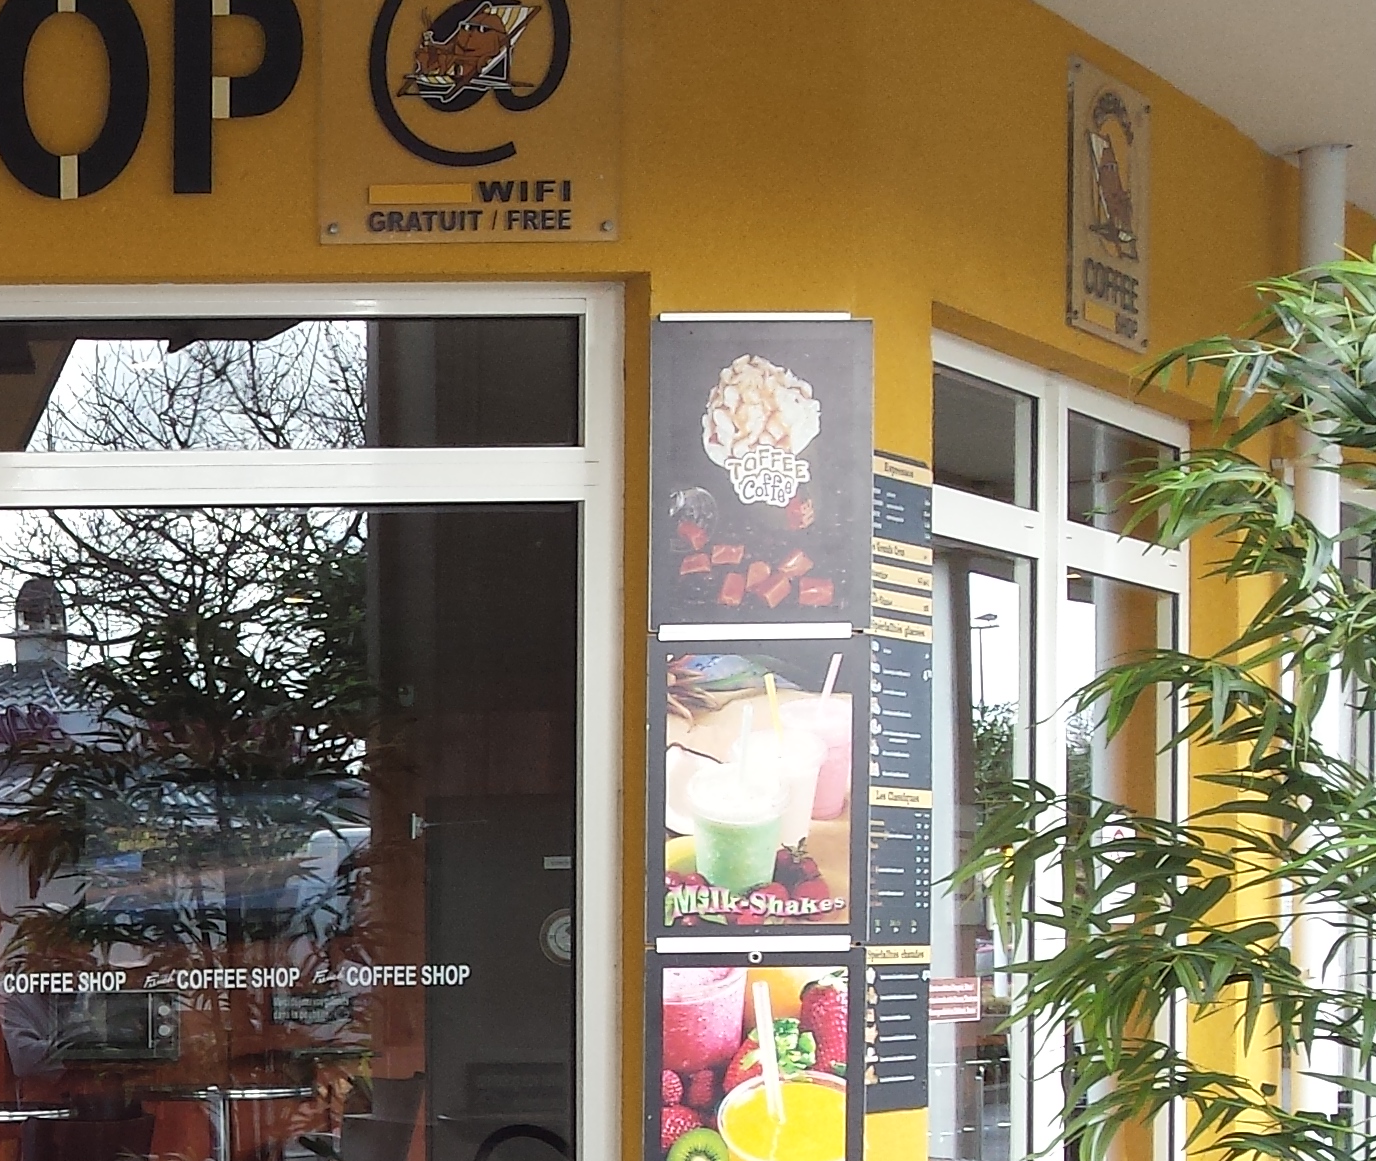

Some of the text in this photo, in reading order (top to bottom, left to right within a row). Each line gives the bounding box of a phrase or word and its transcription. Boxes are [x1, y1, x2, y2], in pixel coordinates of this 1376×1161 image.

[477, 180, 573, 204] WIFI
[366, 208, 484, 234] GRATUIT
[505, 207, 573, 232] FREE
[726, 448, 809, 481] TOFFEE
[3, 972, 74, 995] COFFEE
[76, 971, 127, 992] SHOP
[176, 969, 247, 990] COFFEE
[251, 967, 301, 988] SHOP
[347, 966, 417, 987] COFFEE
[420, 965, 471, 986] SHOP
